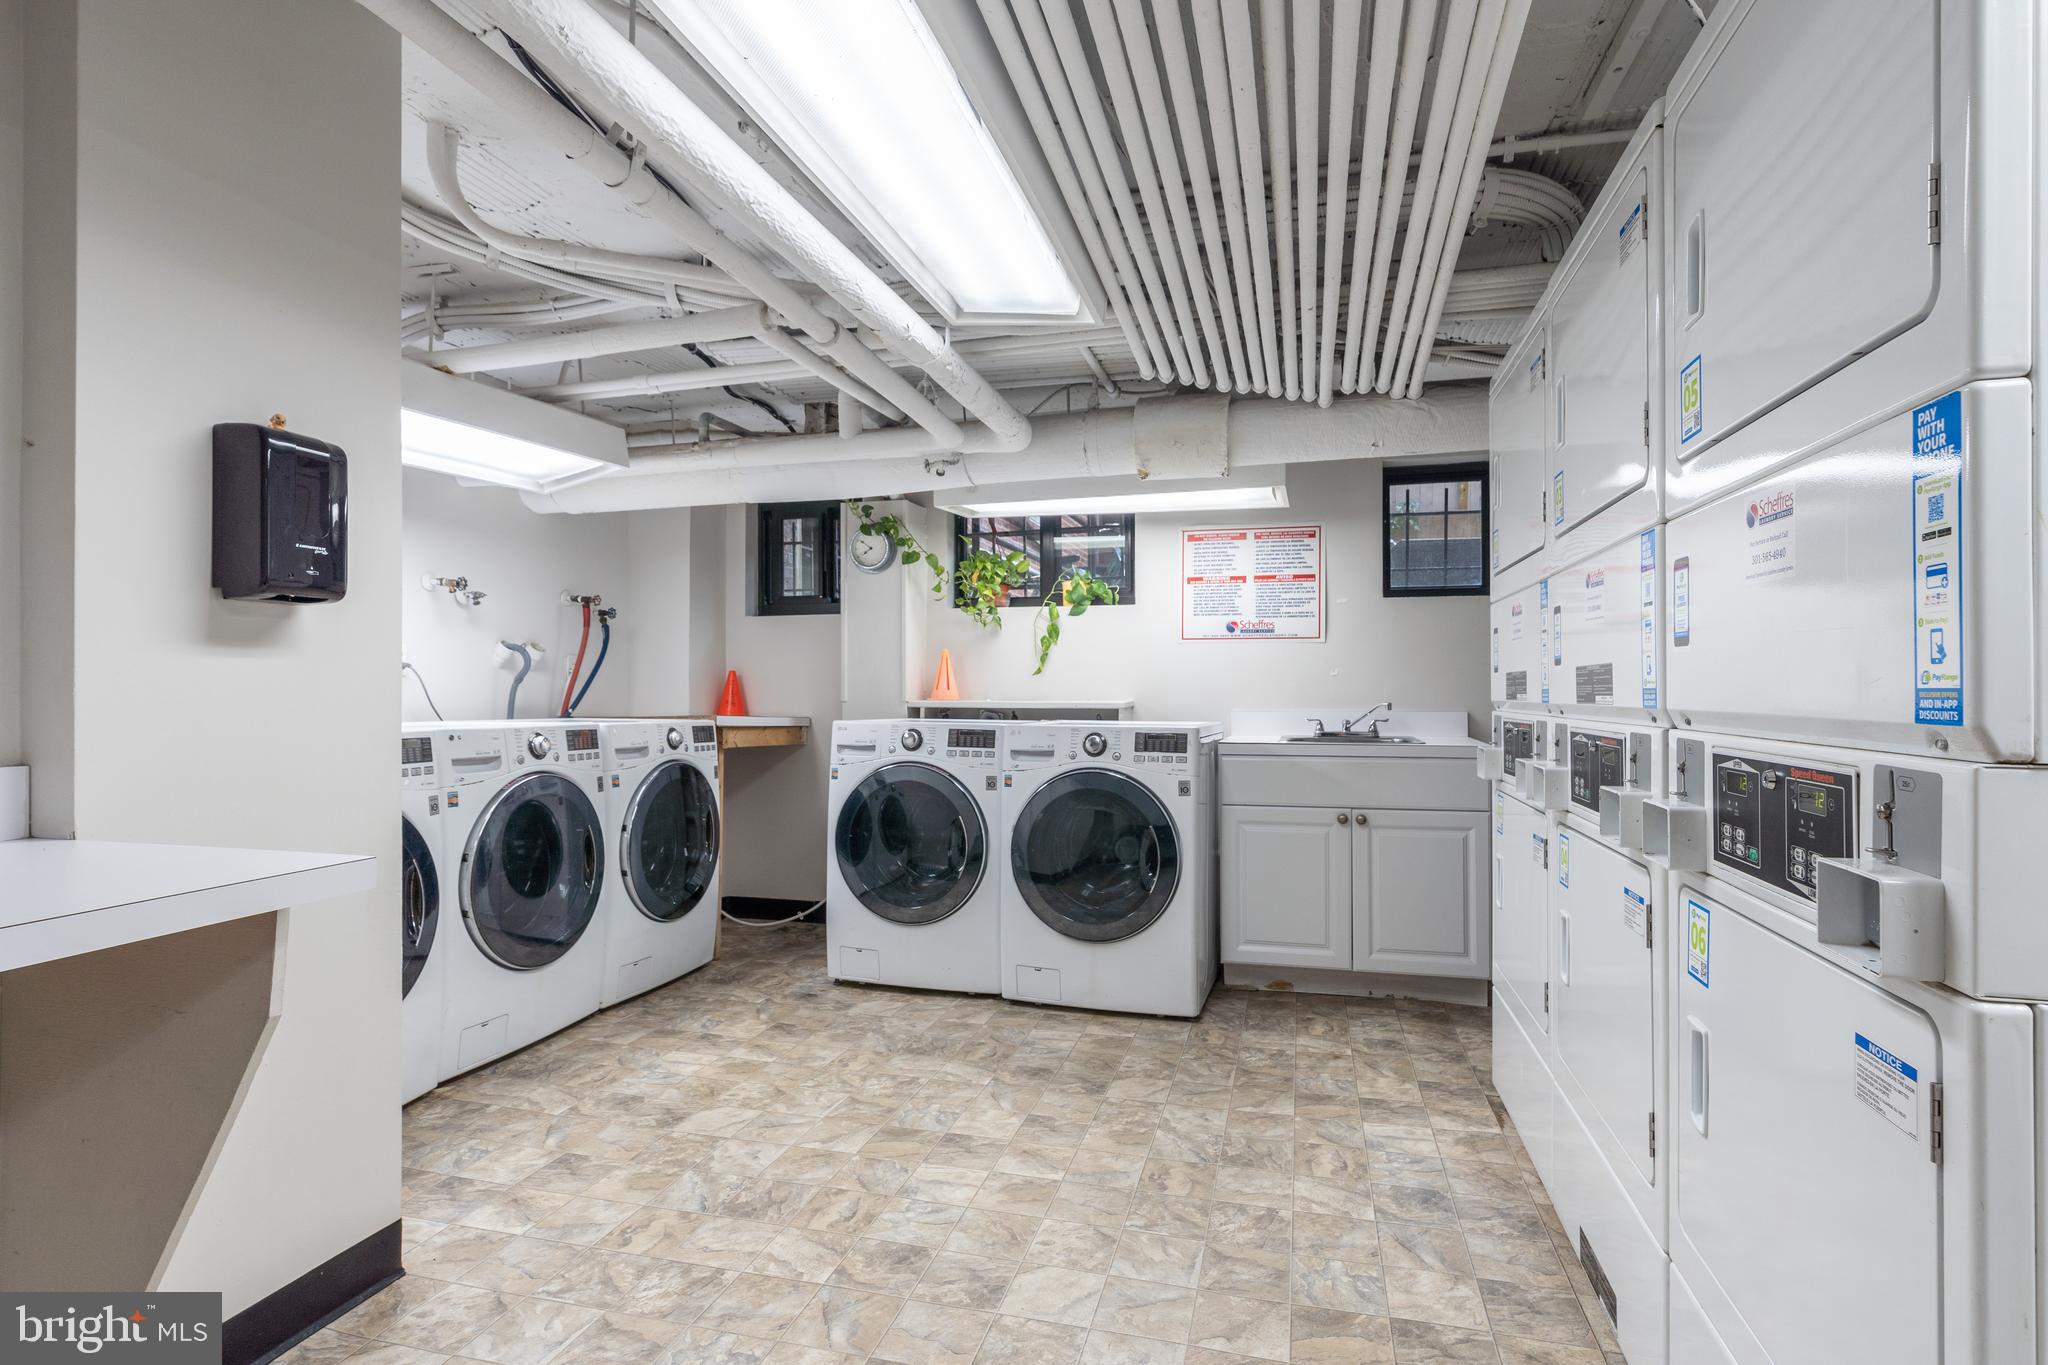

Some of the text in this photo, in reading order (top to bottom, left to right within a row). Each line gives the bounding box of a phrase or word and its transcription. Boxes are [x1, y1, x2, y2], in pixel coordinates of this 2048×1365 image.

[1684, 377, 1698, 413] 05
[1918, 406, 1937, 427] PAY
[1918, 417, 1945, 441] WITH
[1917, 432, 1946, 454] YOUR
[1759, 491, 1794, 517] Scheffres
[1240, 620, 1275, 629] Scheffres
[1932, 674, 1958, 682] PayRange
[1919, 699, 1958, 709] AND IN-APP
[1919, 710, 1959, 720] DISCOUNTS
[1739, 775, 1747, 790] 12
[1791, 767, 1834, 784] Speed Queen
[1815, 792, 1824, 808] 12
[1691, 921, 1706, 955] 06
[1868, 1042, 1902, 1072] NOTICE
